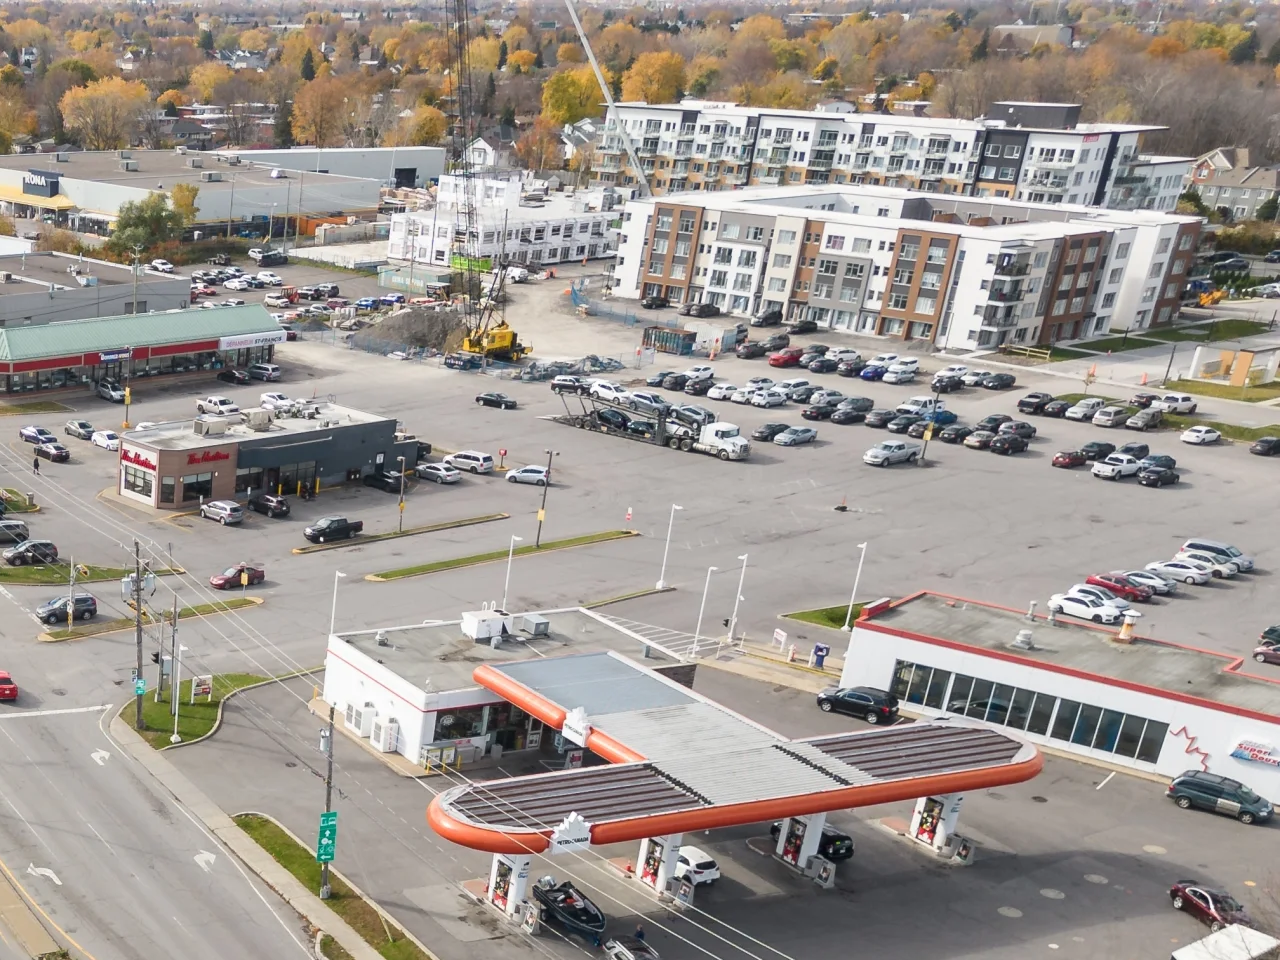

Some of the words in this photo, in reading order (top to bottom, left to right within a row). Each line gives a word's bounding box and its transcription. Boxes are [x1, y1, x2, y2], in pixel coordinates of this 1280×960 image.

[24, 173, 46, 187] RONA
[121, 448, 133, 463] Tim
[133, 452, 156, 472] Hortons
[187, 452, 201, 465] Tim
[201, 450, 230, 463] Hortons
